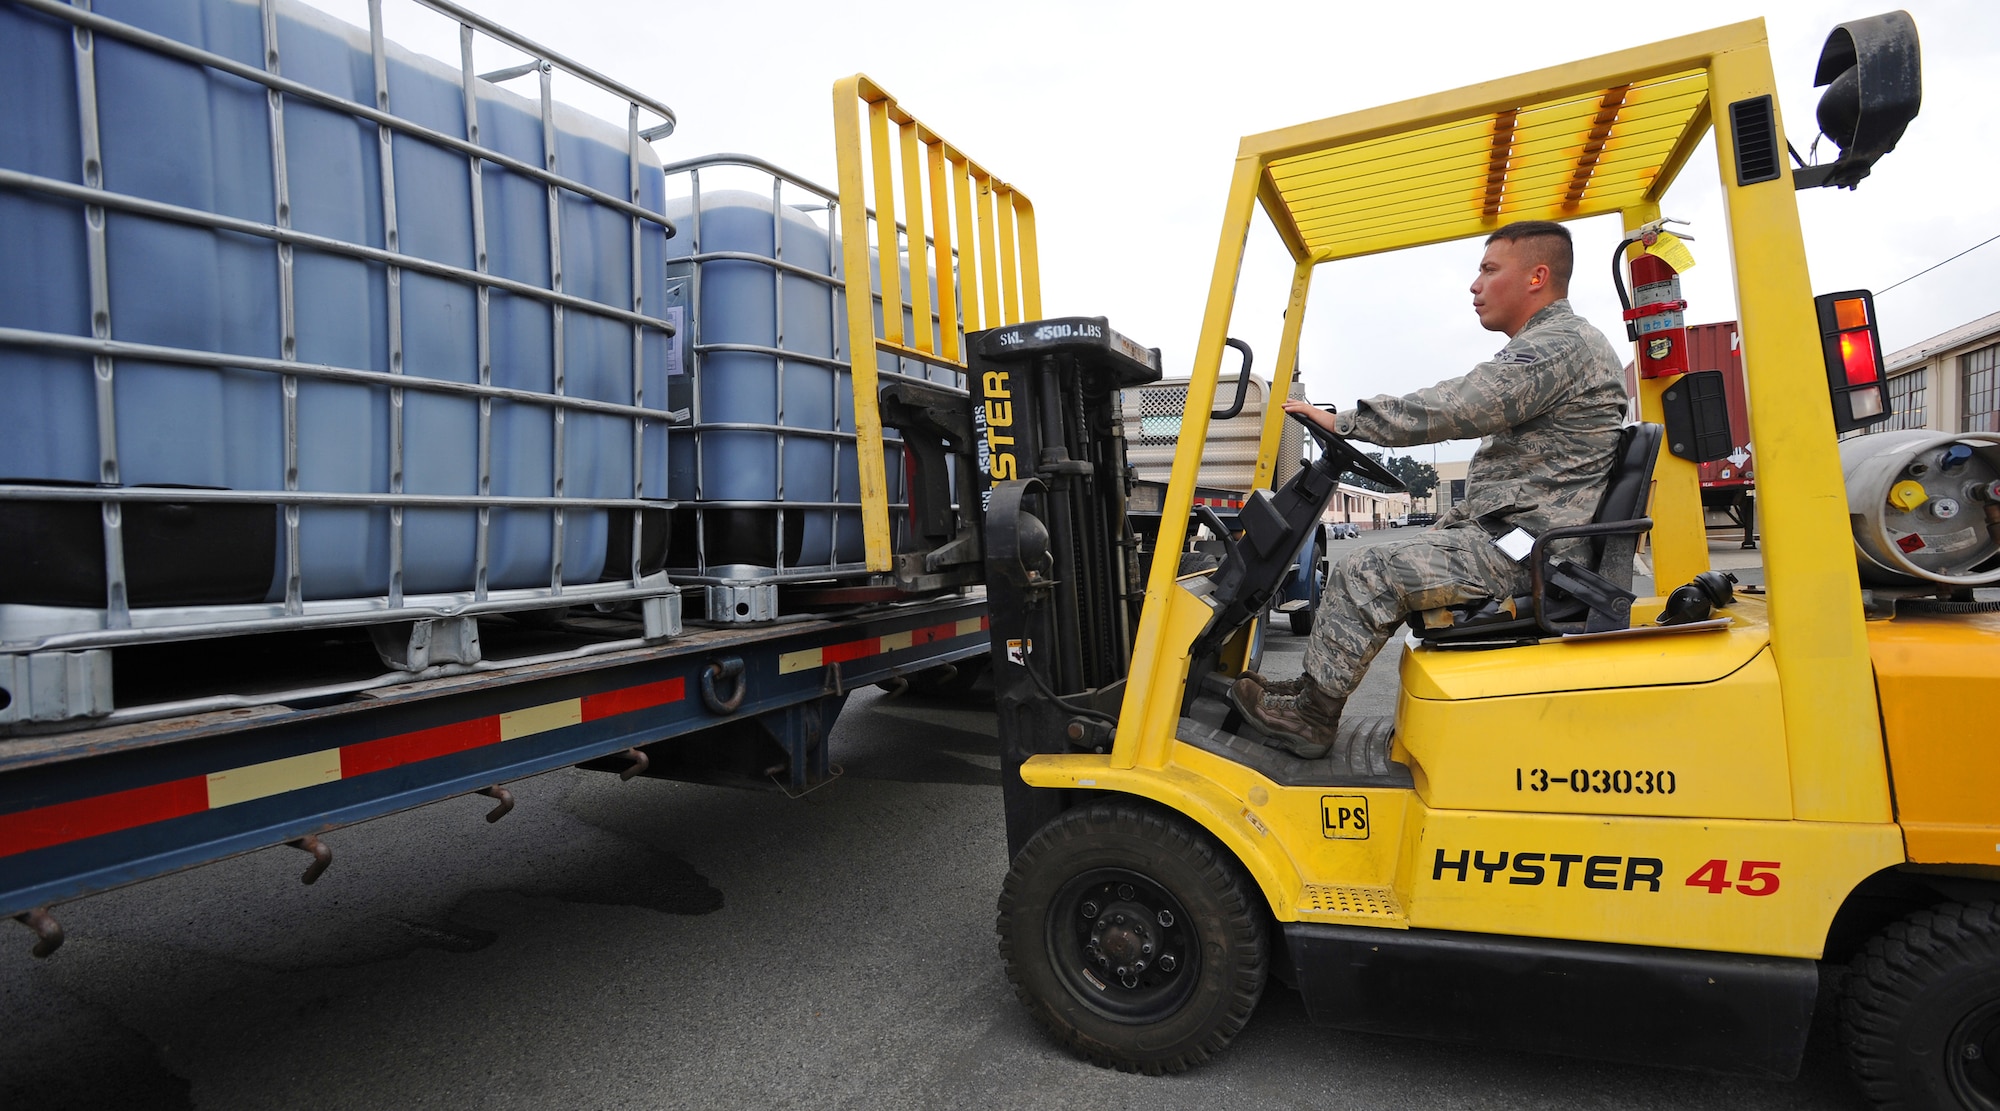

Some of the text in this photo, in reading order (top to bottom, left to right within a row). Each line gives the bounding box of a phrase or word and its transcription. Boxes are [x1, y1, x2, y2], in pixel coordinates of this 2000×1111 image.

[983, 371, 1017, 488] STER
[1516, 768, 1676, 795] 13-03030
[1323, 806, 1367, 831] LPS
[1432, 848, 1782, 897] HYSTER 45
